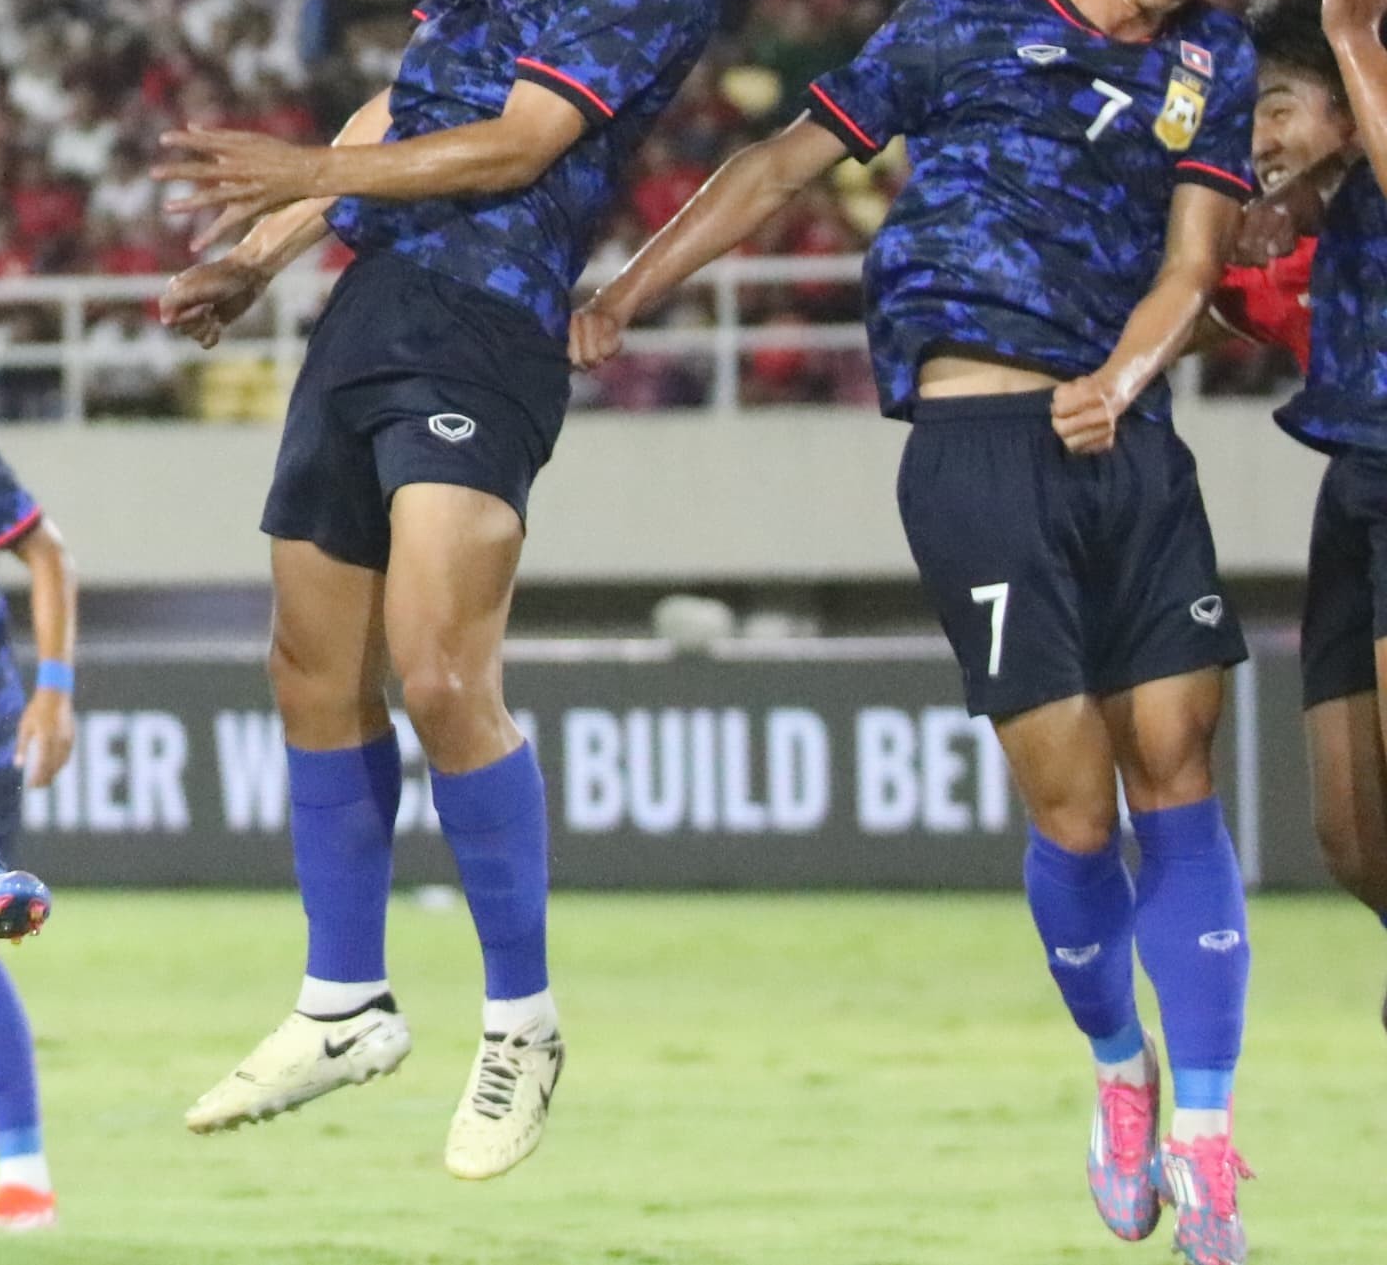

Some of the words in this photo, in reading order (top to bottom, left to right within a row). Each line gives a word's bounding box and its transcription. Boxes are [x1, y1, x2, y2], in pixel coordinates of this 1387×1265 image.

[1085, 78, 1133, 142] 7
[970, 582, 1010, 678] 7
[563, 705, 832, 834] BUILD
